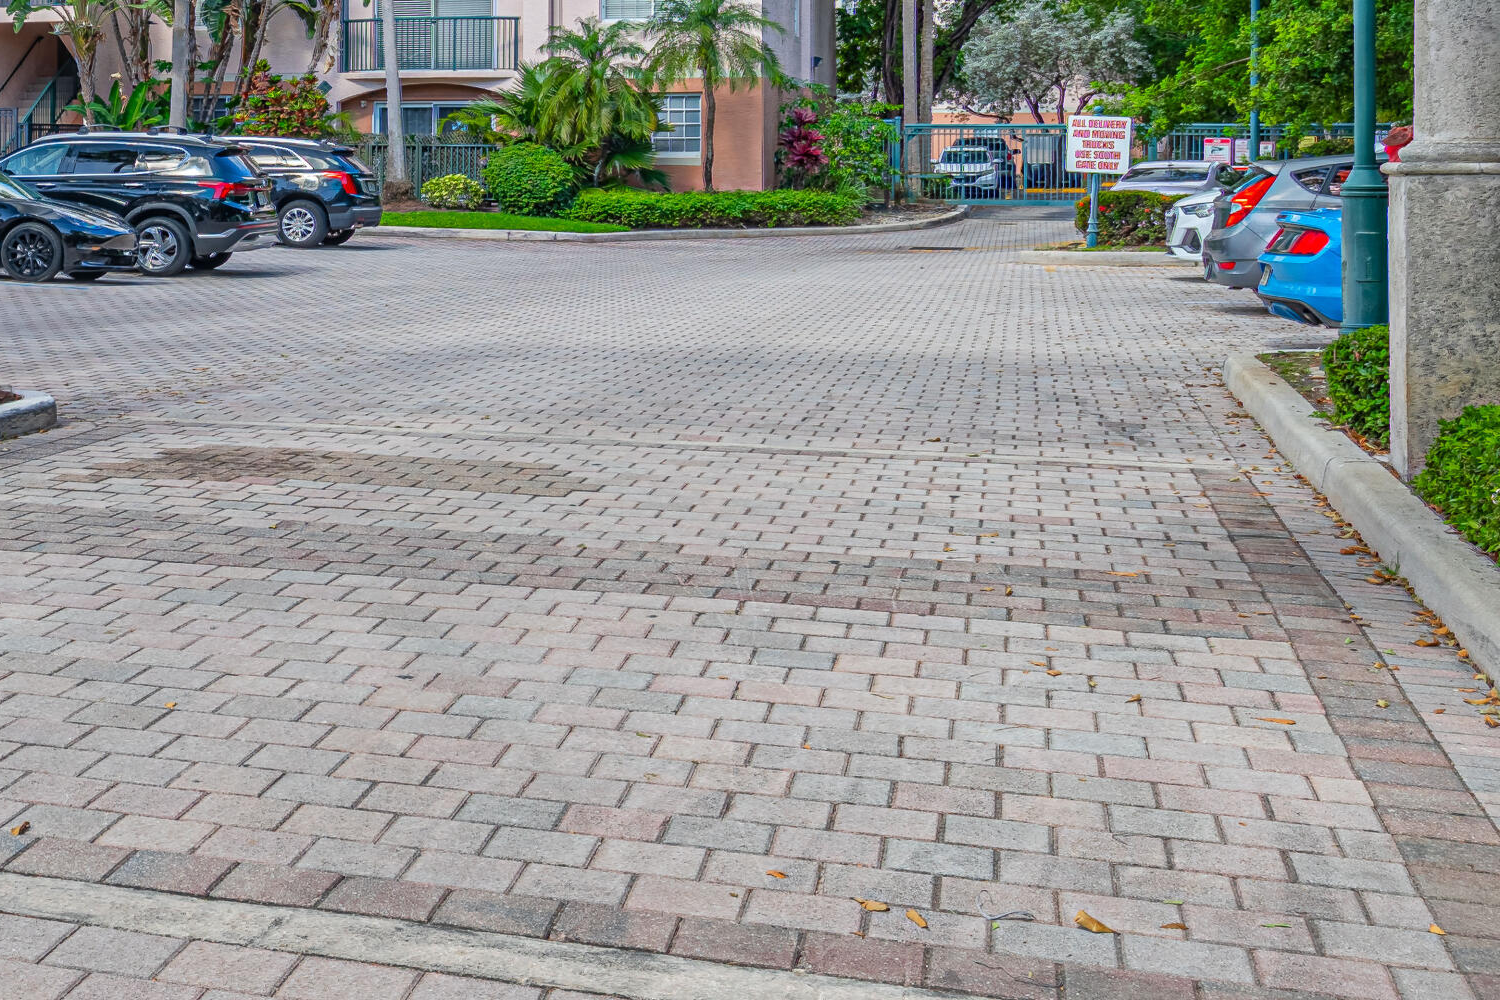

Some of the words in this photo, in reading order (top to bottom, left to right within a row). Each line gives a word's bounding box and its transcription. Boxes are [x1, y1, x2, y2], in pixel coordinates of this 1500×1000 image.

[1072, 119, 1086, 127] ALL
[1089, 120, 1127, 129] DELIVERY
[1073, 130, 1090, 138] AND
[1092, 130, 1125, 139] MOVING
[1082, 140, 1115, 149] TRUCKS
[1075, 150, 1091, 158] USE
[1094, 151, 1121, 159] SOUTH
[1076, 160, 1096, 169] GATE
[1098, 161, 1119, 170] ONLY
